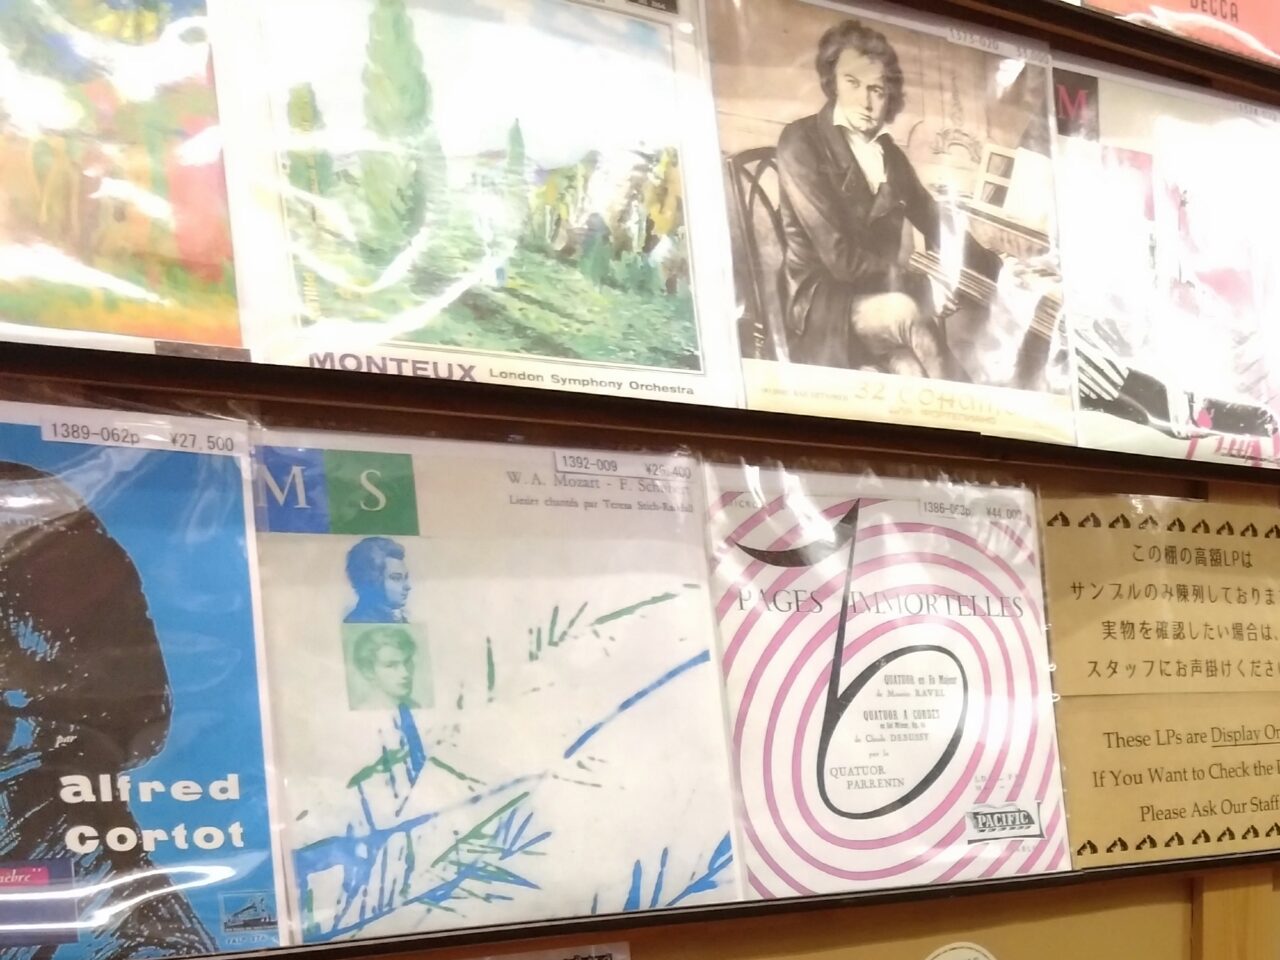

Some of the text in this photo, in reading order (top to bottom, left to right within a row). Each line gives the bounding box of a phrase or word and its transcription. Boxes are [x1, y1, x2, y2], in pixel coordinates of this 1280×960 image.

[1055, 84, 1090, 121] M
[308, 351, 695, 396] MONTEUX London Symphony Orchestra
[51, 422, 141, 446] 1389-062p
[562, 455, 619, 473] 1392-009
[256, 464, 388, 512] M S
[1131, 543, 1254, 569] この棚の高額LPは
[736, 588, 1025, 619] PAGES IMMORTELLES
[1101, 619, 1280, 643] 実物を確認したい場合は、
[1103, 730, 1151, 749] These
[1155, 727, 1183, 747] LPs
[1186, 731, 1208, 745] are
[1211, 724, 1261, 744] Display
[829, 765, 886, 779] QUATUOR
[846, 777, 906, 790] PARRENIN
[1092, 771, 1106, 788] If
[1106, 769, 1143, 787] You
[1147, 766, 1188, 785] Want
[1192, 765, 1206, 781] to
[1208, 760, 1250, 780] Check
[1253, 760, 1274, 777] the
[59, 773, 240, 804] alfred
[976, 811, 1030, 828] PACIFIC
[1140, 803, 1187, 823] Please
[1191, 799, 1217, 818] Ask
[1221, 797, 1248, 816] Our
[65, 821, 245, 855] cortot
